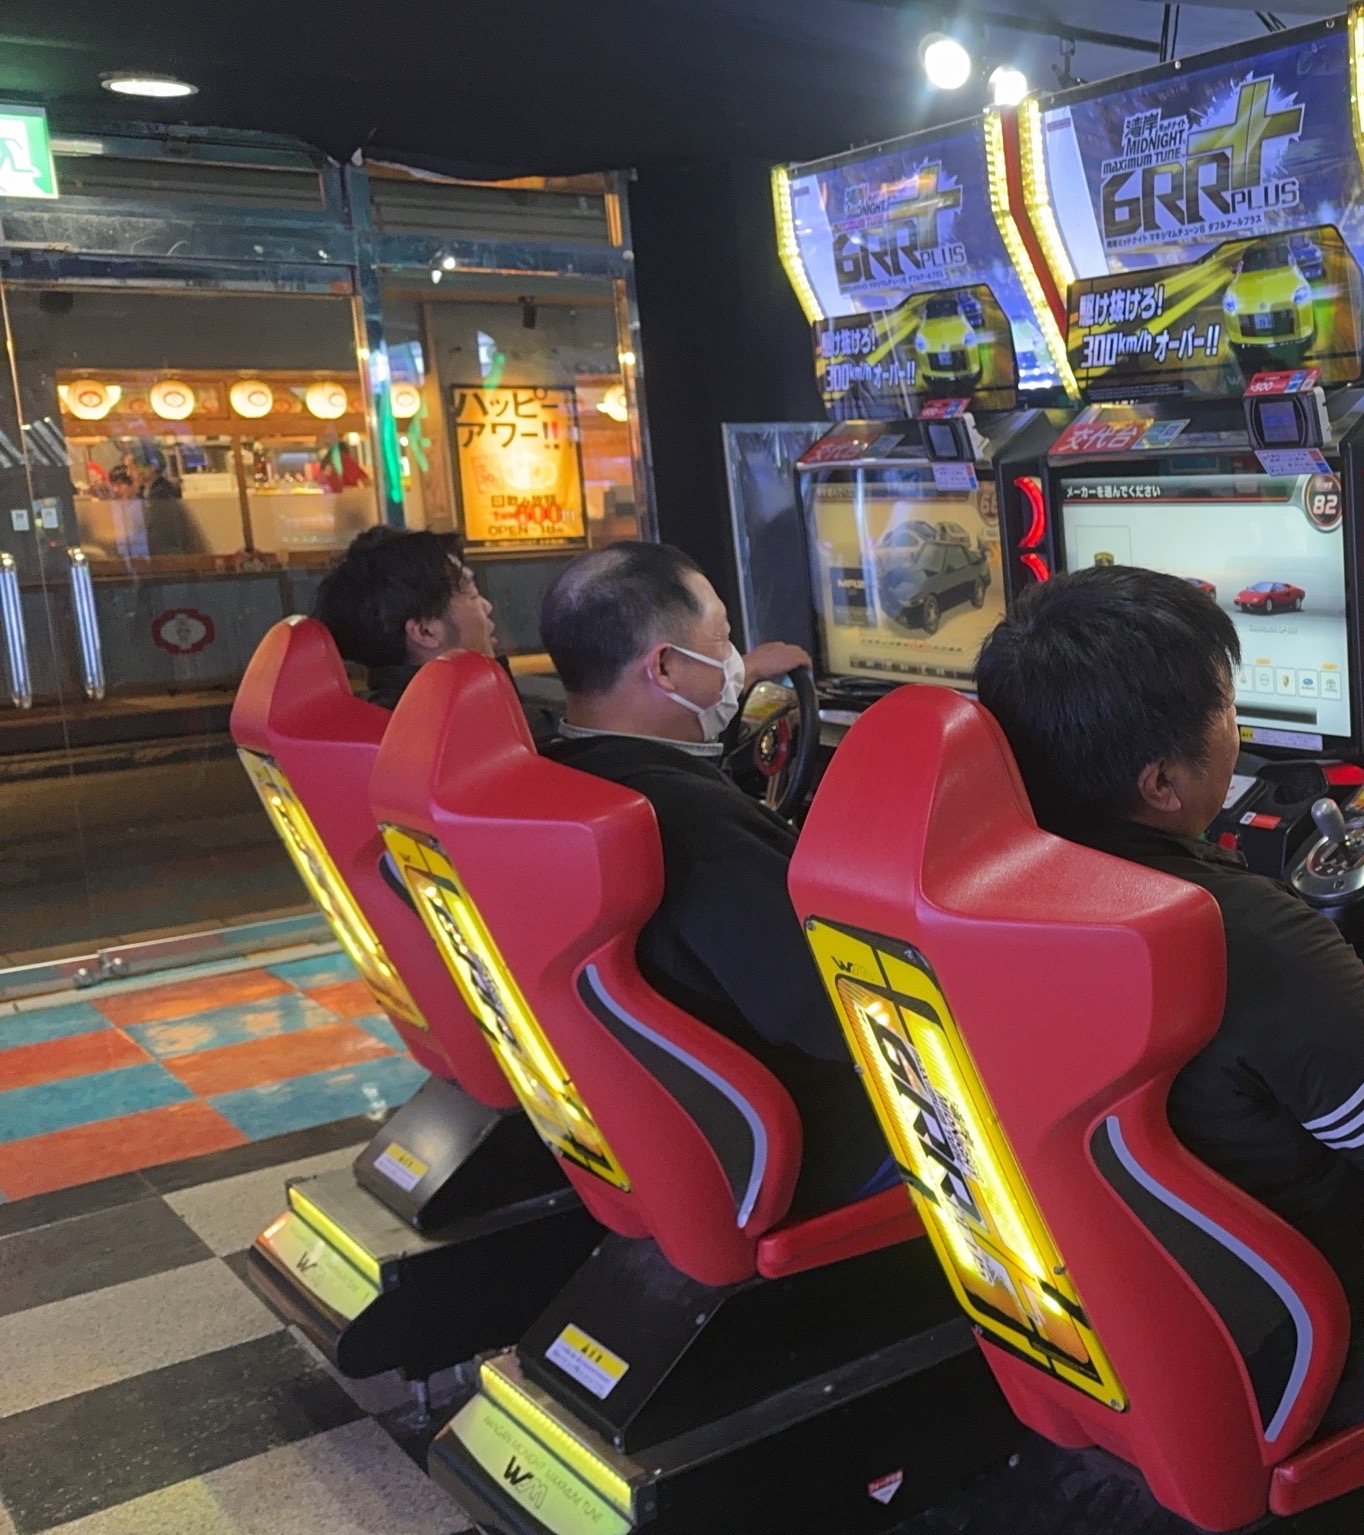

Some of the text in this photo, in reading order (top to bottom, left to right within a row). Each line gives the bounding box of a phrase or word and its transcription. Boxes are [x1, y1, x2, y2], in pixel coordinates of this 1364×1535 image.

[1126, 130, 1184, 156] MIDNIGHT
[1231, 180, 1299, 214] PLUS
[454, 388, 559, 419] ハッピー
[1312, 494, 1339, 515] 82
